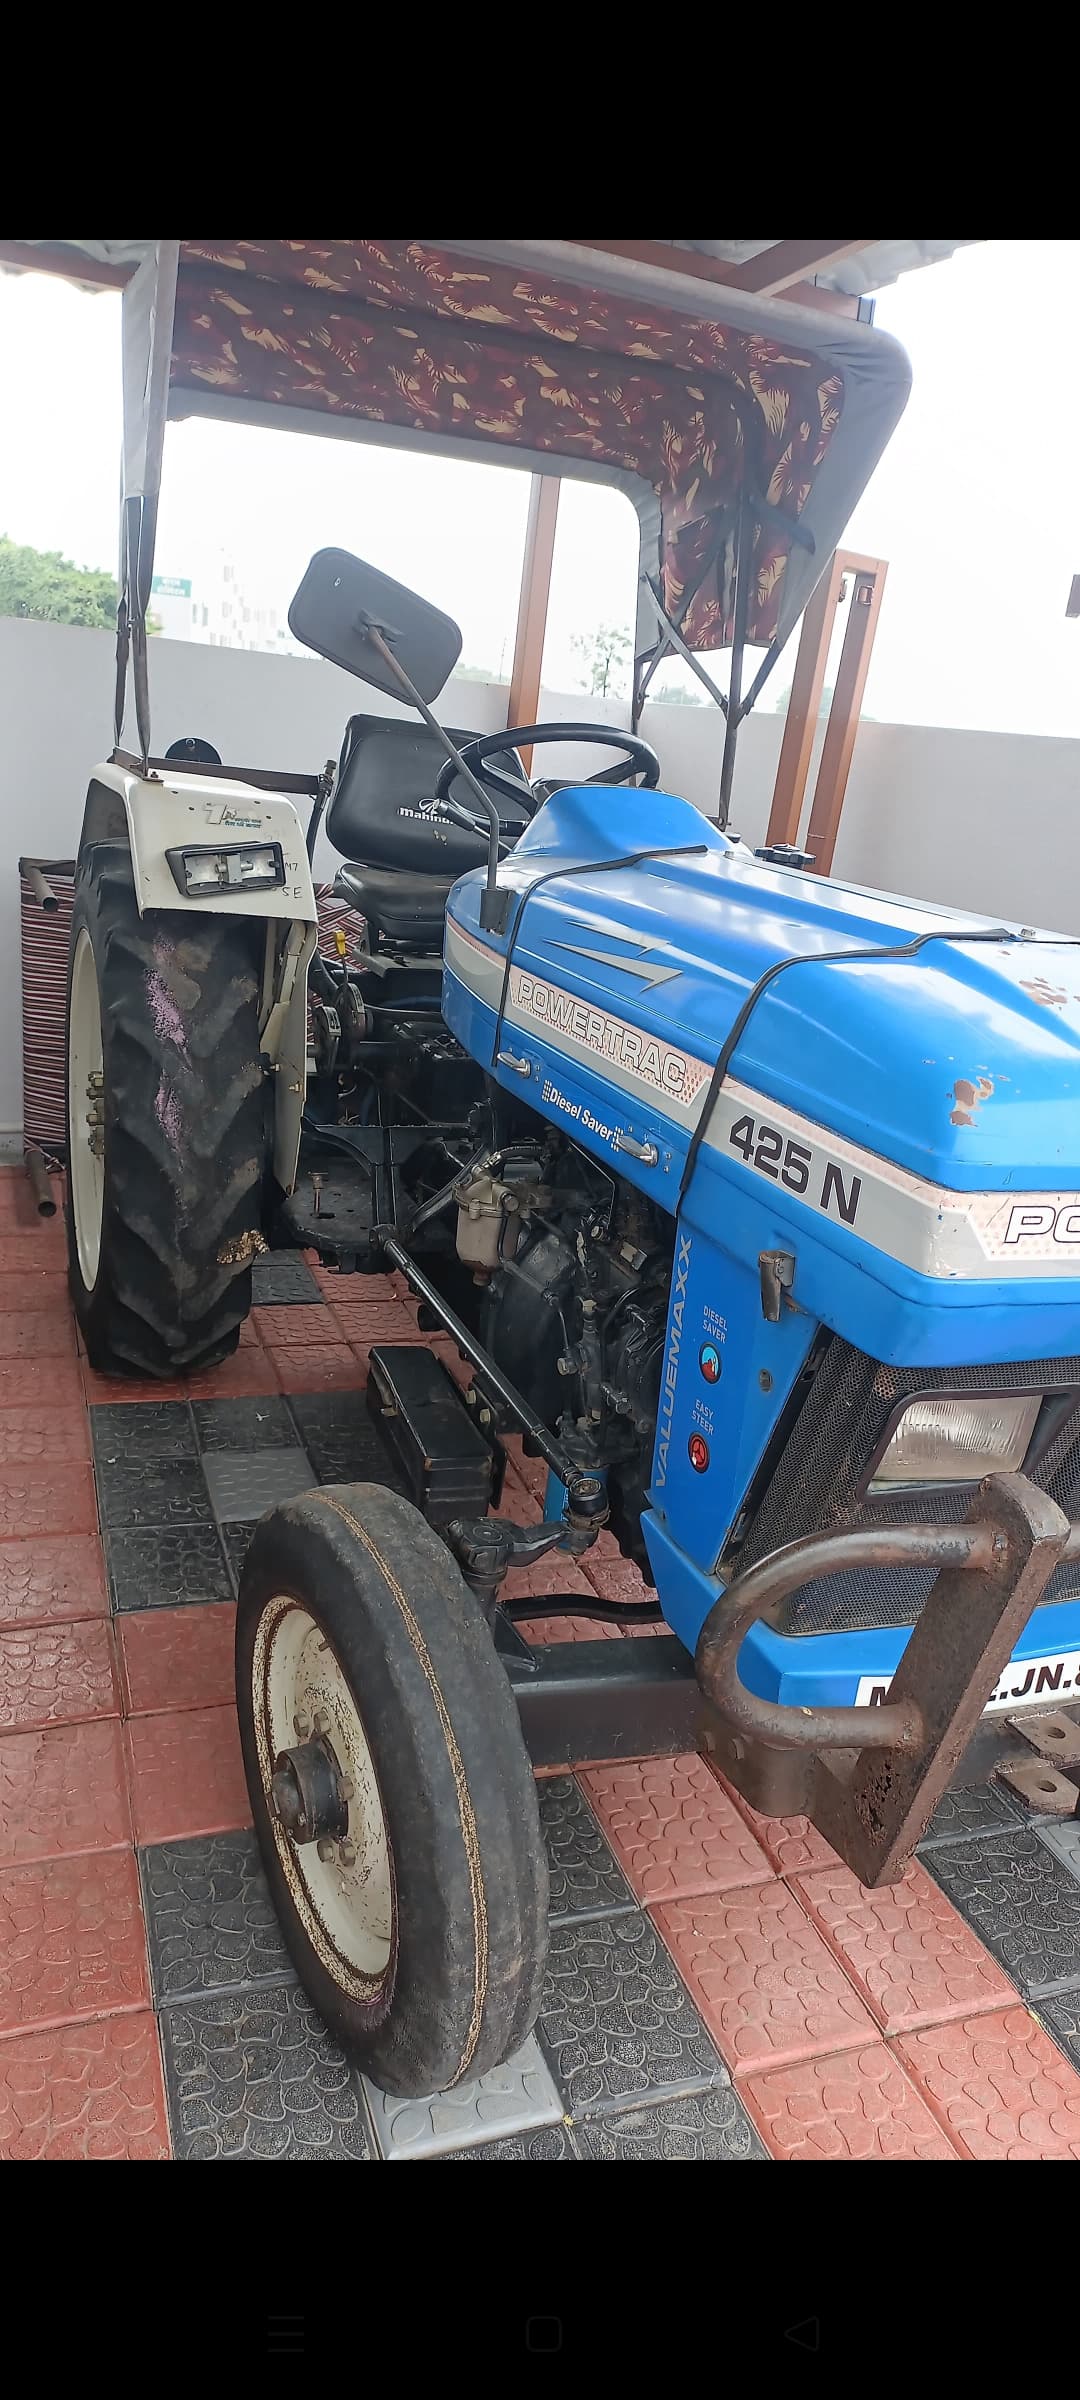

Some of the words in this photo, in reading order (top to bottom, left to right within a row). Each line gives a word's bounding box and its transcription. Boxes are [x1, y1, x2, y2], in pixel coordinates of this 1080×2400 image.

[518, 975, 687, 1093] POWERTRAC
[550, 1089, 582, 1119] Diesel
[581, 1107, 614, 1141] Saver
[729, 1115, 813, 1194] 425
[819, 1161, 862, 1226] N
[702, 1319, 726, 1343] SAVER
[703, 1305, 728, 1331] DIESEL
[656, 1235, 692, 1487] VALUEMAXX
[691, 1410, 714, 1435] STEER
[696, 1399, 714, 1420] EASY
